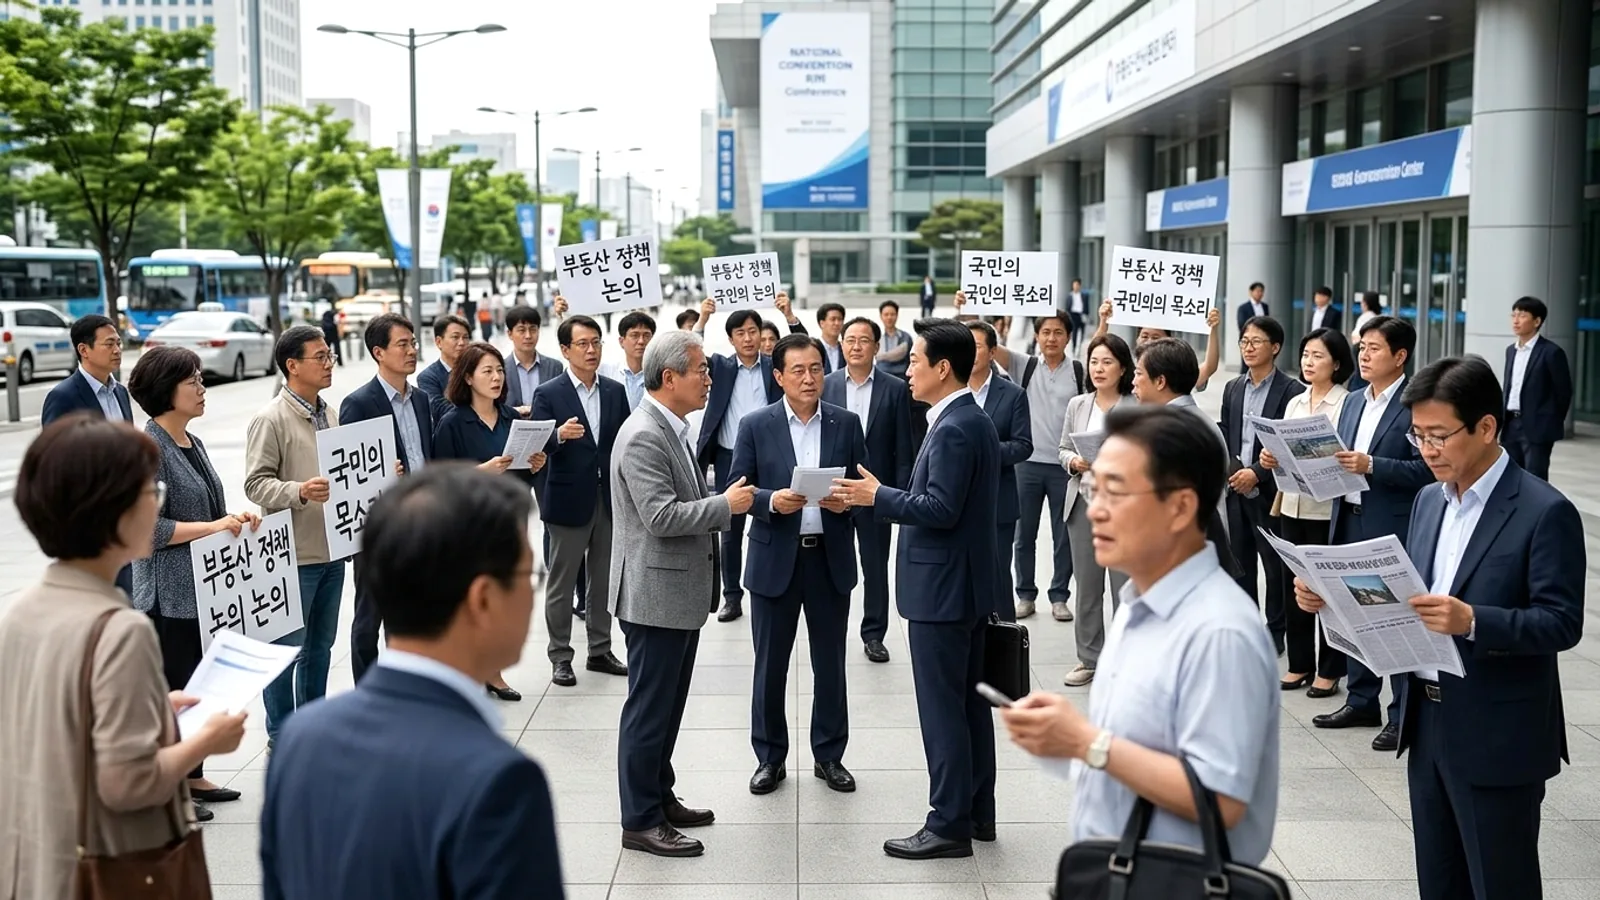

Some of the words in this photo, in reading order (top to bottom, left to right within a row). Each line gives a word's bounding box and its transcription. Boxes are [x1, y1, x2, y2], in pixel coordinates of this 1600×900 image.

[563, 248, 610, 278] 부동산
[968, 256, 1020, 277] 국민의
[1118, 258, 1165, 282] 부동산
[1171, 263, 1204, 287] 정책
[601, 273, 643, 303] 논의
[964, 284, 1006, 305] 국민의
[1012, 284, 1052, 306] 목소리
[1113, 290, 1167, 315] 국민의의
[1171, 295, 1210, 319] 목소리
[328, 438, 385, 490] 국민의
[203, 538, 253, 597] 부동산
[251, 577, 290, 628] 논의
